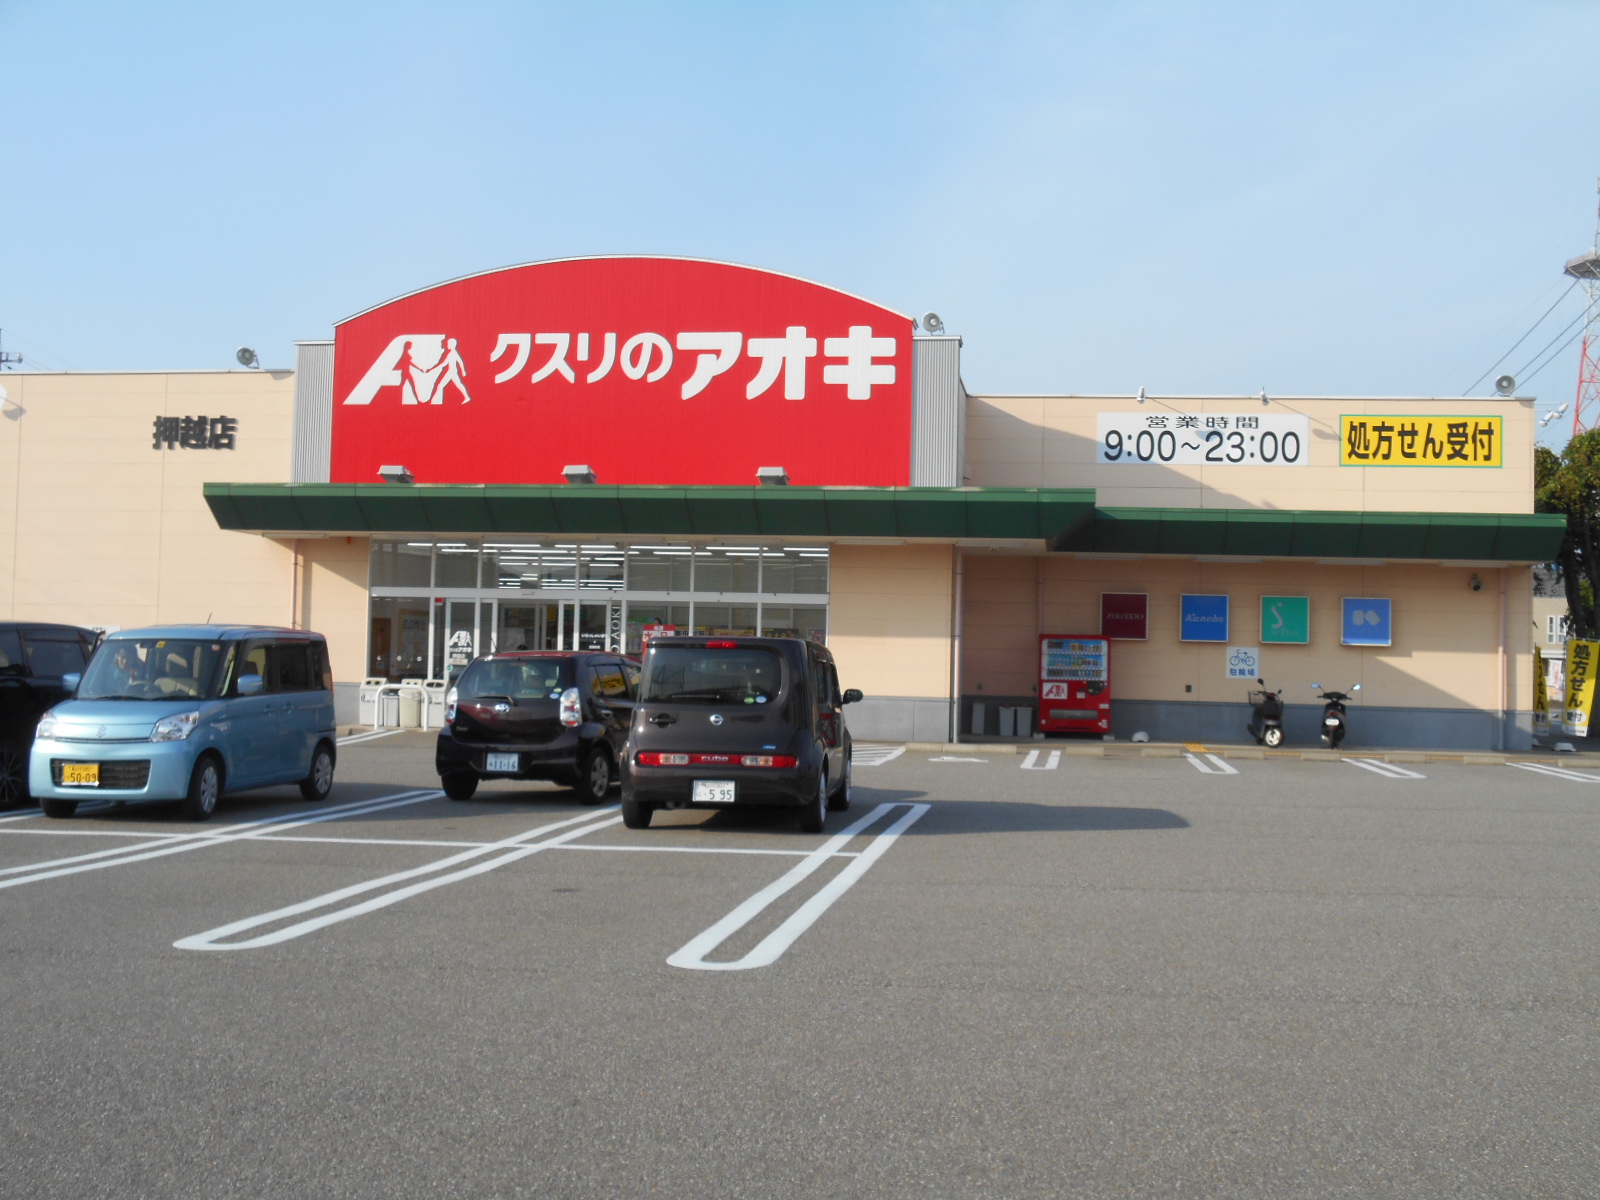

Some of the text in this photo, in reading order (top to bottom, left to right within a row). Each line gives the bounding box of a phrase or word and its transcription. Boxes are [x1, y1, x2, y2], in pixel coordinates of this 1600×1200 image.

[489, 325, 898, 402] クスリのアオキ
[152, 415, 238, 450] 押越店
[1145, 415, 1260, 429] 営業時間
[1346, 420, 1496, 463] 処方せん受付
[1184, 613, 1225, 623] Kanebo
[1229, 668, 1256, 677] 駐輪場
[1568, 643, 1591, 708] 処方せん
